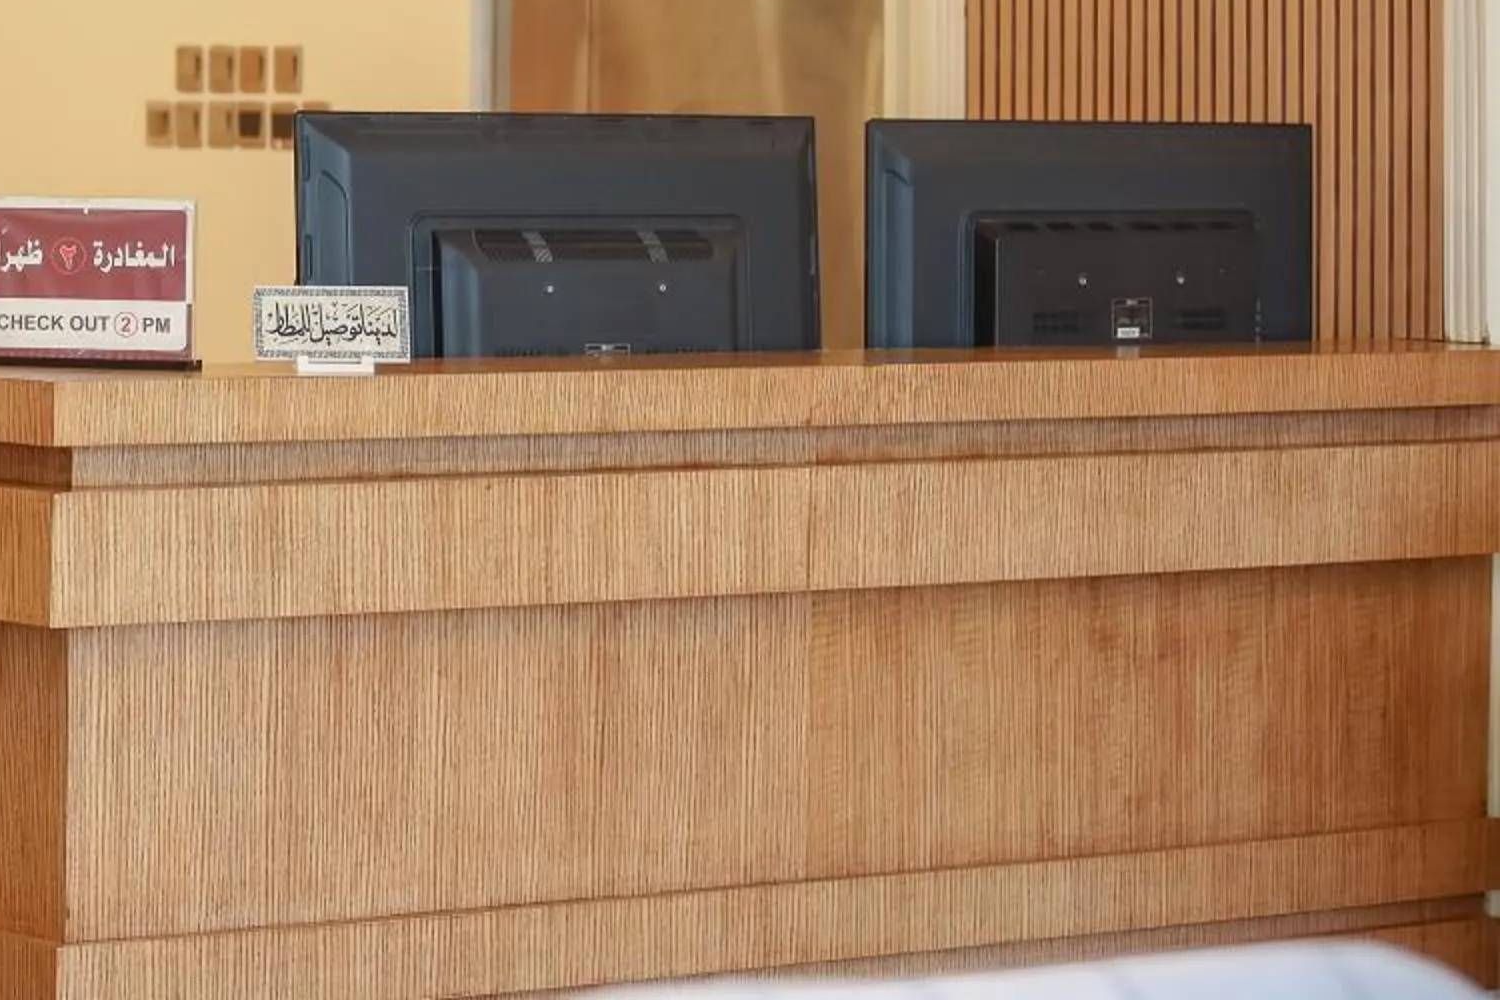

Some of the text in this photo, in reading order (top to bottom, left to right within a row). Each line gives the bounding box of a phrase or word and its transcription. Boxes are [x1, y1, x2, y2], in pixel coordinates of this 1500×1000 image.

[92, 238, 176, 274] المغادرة
[69, 315, 109, 332] OUT
[120, 317, 132, 333] 2
[142, 317, 171, 333] PM
